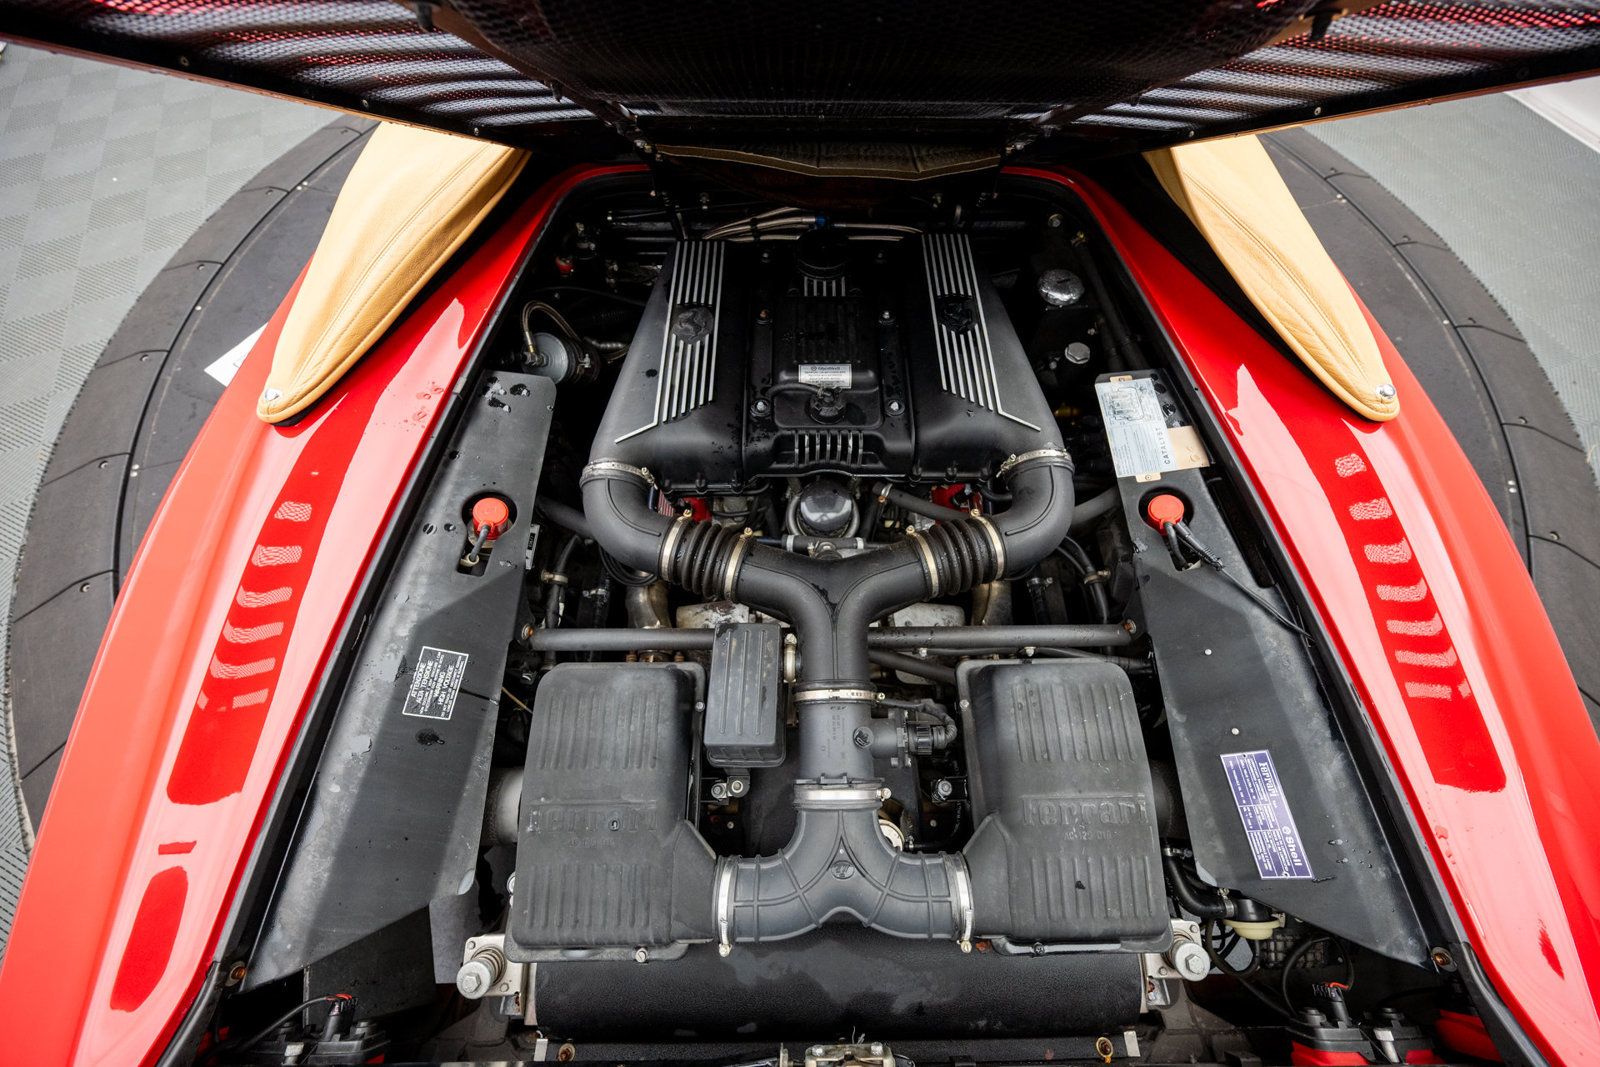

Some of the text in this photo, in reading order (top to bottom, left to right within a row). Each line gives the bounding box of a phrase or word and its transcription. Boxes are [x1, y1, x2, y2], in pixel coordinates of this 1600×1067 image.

[1154, 427, 1171, 464] CATALYST
[410, 661, 426, 697] ATTENZIONE
[419, 659, 434, 688] TENSIONE
[432, 670, 446, 698] WARNING
[441, 663, 455, 689] VOLTAGE
[414, 689, 425, 703] ALTA
[436, 690, 447, 705] HIGH
[1021, 793, 1149, 826] Ferrari
[1257, 761, 1279, 797] Ferrari
[1284, 835, 1303, 866] Shell
